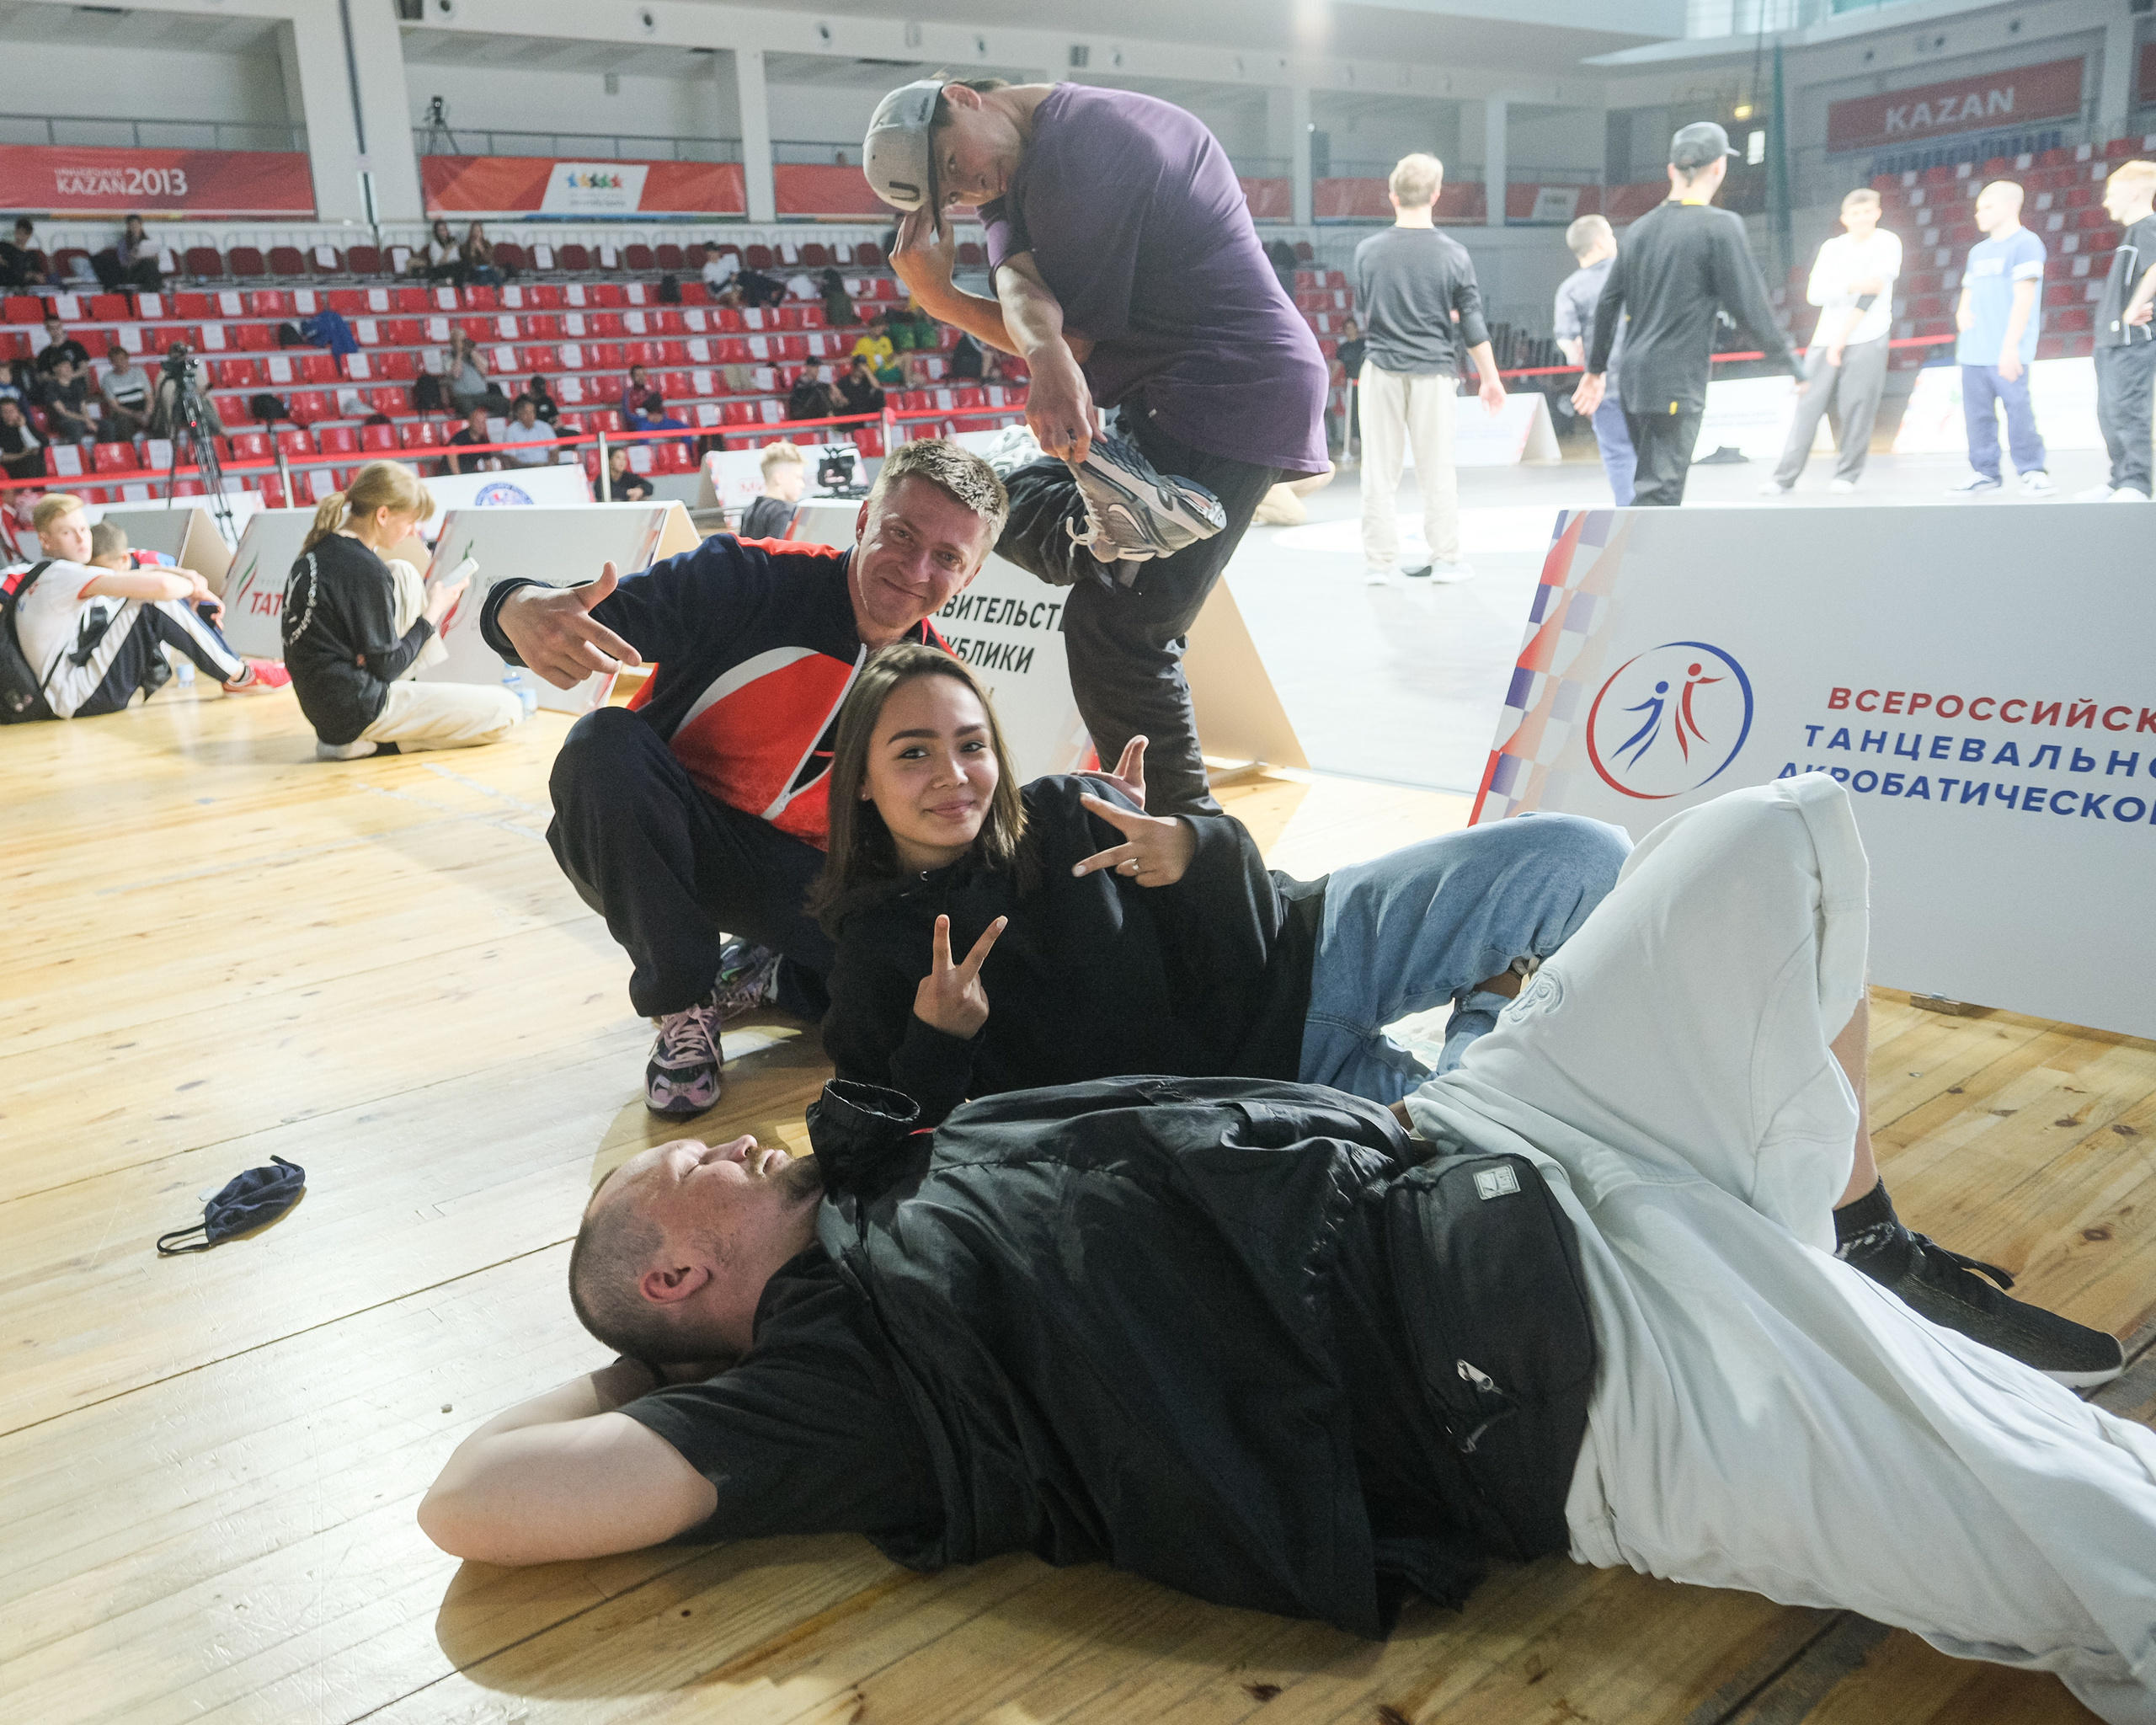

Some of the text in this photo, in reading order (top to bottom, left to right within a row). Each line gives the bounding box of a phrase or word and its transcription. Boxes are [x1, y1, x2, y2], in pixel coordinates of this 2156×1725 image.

[1885, 88, 2015, 133] KAZAN
[936, 594, 1065, 632] ВИТЕЛЬСТ
[942, 634, 1035, 674] УБЛИКИ
[1828, 687, 2156, 734] ВСЕРОССИЙСК
[1805, 724, 2156, 779] ТАНЦЕВАЛЬН
[1778, 762, 2156, 825] АРОБАТИЧЕСКО
